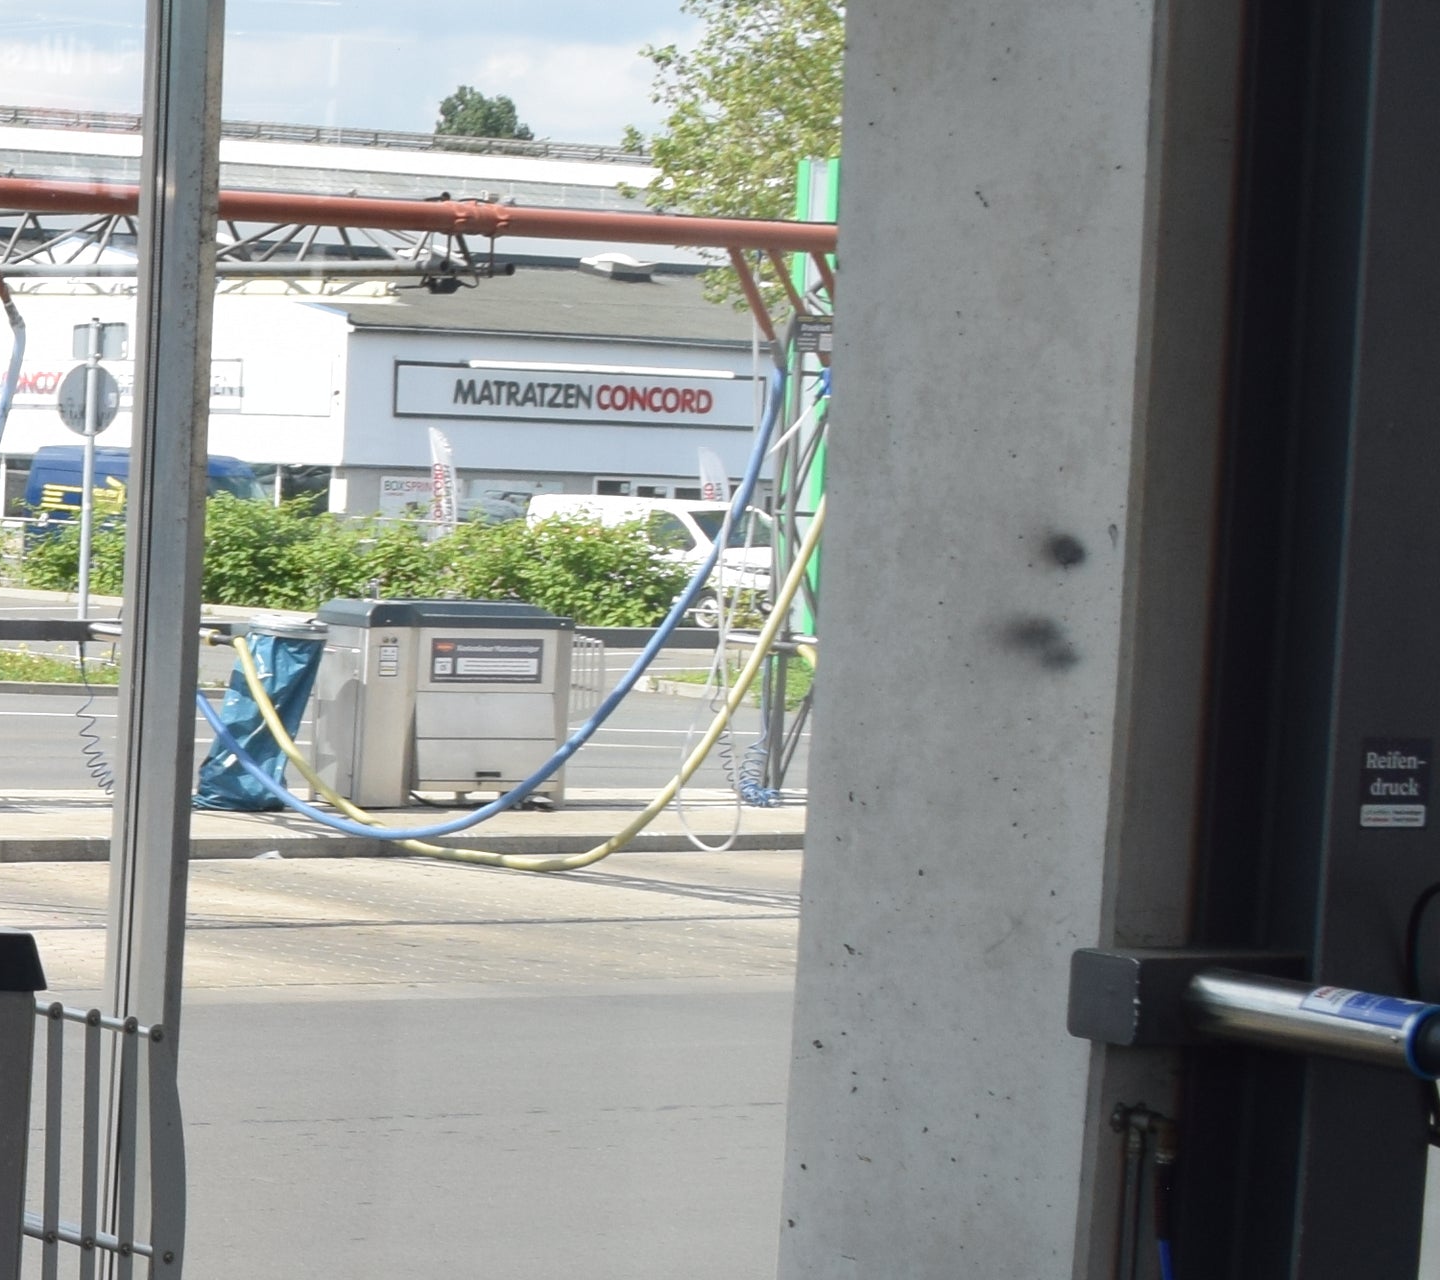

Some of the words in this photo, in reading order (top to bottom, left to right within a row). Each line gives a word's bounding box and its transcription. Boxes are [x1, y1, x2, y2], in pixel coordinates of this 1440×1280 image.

[453, 379, 592, 412] MATRATZEN
[596, 383, 713, 415] CONCORD
[1366, 751, 1427, 770] Reifen-
[1370, 778, 1419, 796] druck
